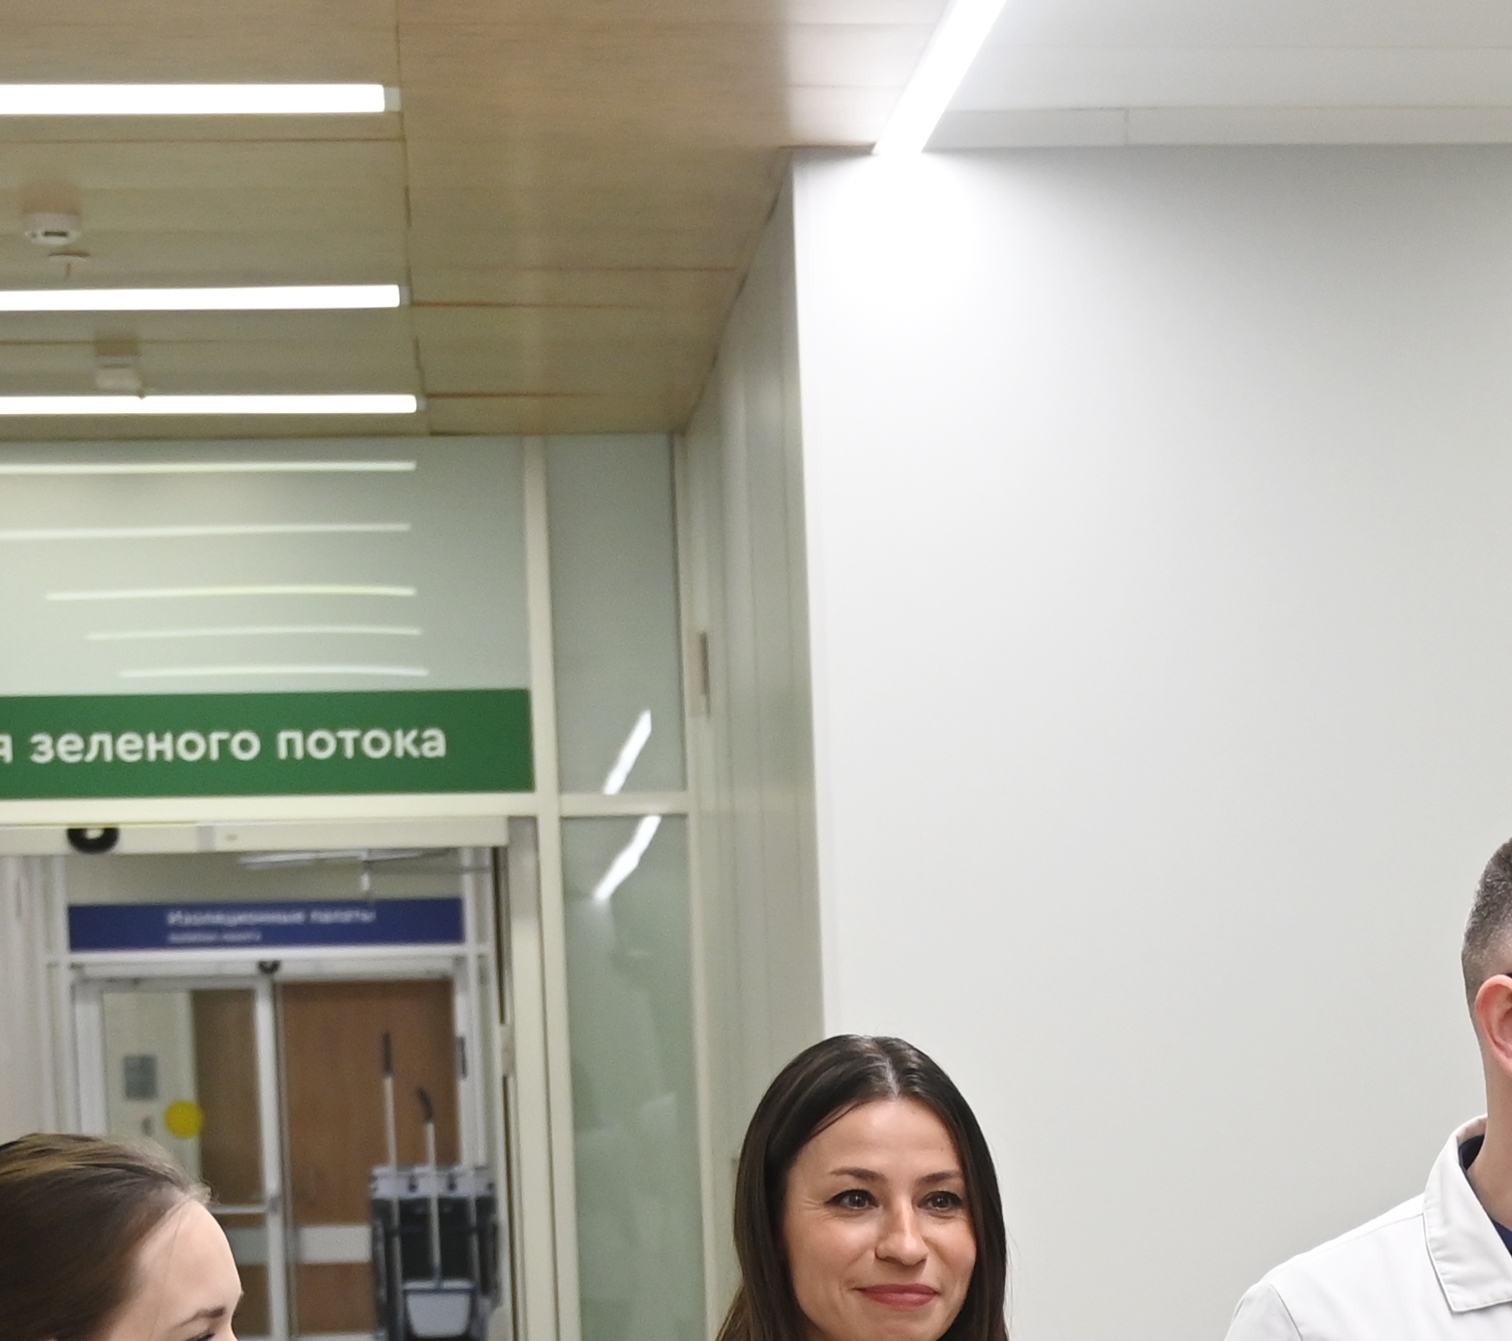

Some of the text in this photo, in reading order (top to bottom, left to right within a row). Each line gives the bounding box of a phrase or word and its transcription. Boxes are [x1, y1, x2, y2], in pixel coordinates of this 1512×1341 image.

[30, 729, 261, 764] зеленого
[276, 727, 447, 761] потока
[167, 909, 377, 927] Изоляционные палаты
